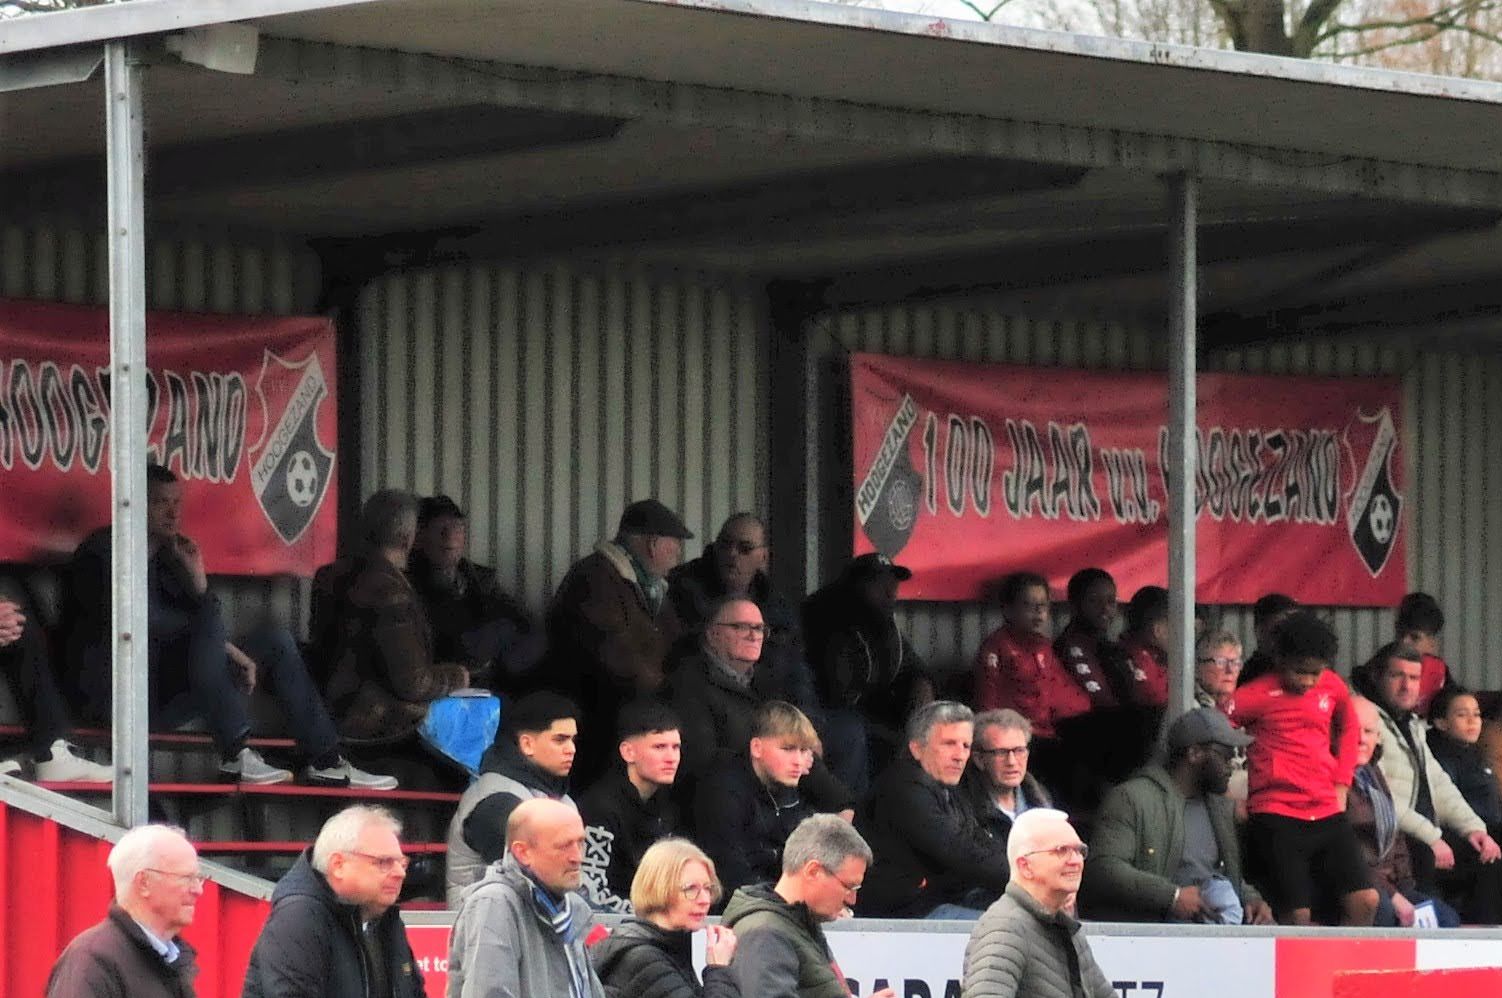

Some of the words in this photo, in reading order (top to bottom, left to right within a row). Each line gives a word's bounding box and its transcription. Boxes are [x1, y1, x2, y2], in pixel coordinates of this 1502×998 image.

[0, 357, 248, 483] OOGAND
[923, 411, 995, 518] 100
[1003, 418, 1101, 522] JAAR
